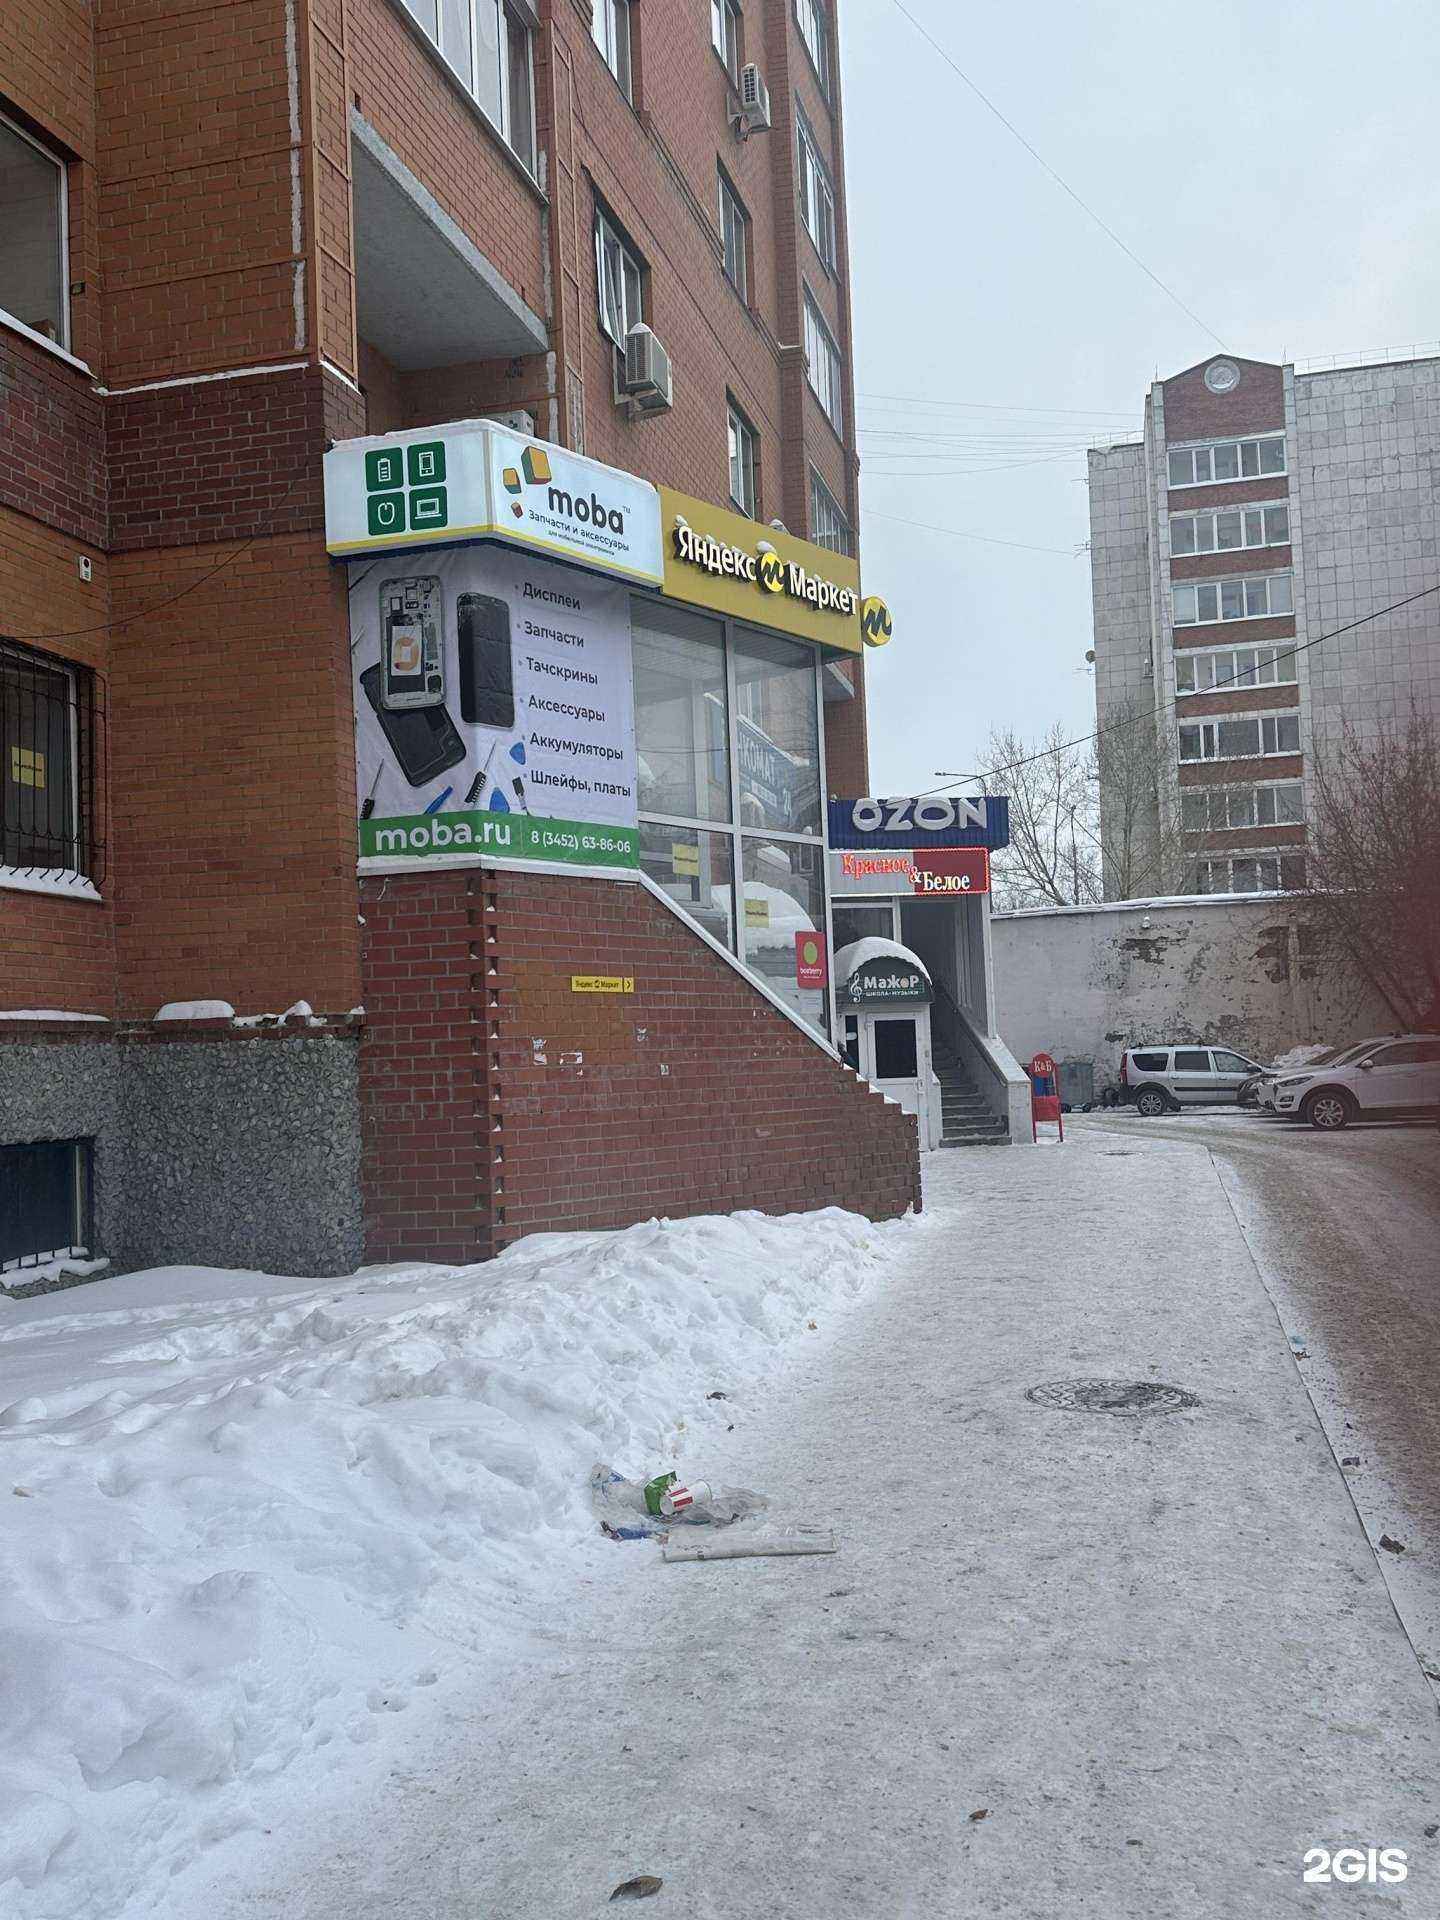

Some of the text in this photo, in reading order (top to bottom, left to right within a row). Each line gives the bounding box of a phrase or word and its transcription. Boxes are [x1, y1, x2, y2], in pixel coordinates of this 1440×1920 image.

[548, 486, 624, 535] moba
[528, 509, 630, 551] Запчасти и аксессуары
[677, 525, 757, 582] Яндекс
[788, 562, 859, 616] Маркет
[524, 621, 585, 648] Запчасти
[526, 657, 598, 685] Тачскрины
[528, 694, 605, 723] Аксессуары
[530, 731, 624, 761] Аккумуляторы
[531, 769, 631, 798] Шлейфы, платы
[852, 797, 988, 832] OZON
[375, 818, 512, 851] moba.ru
[530, 830, 631, 854] 8 (3452) 63-86-06
[842, 853, 910, 880] Красное
[923, 871, 970, 892] Белое
